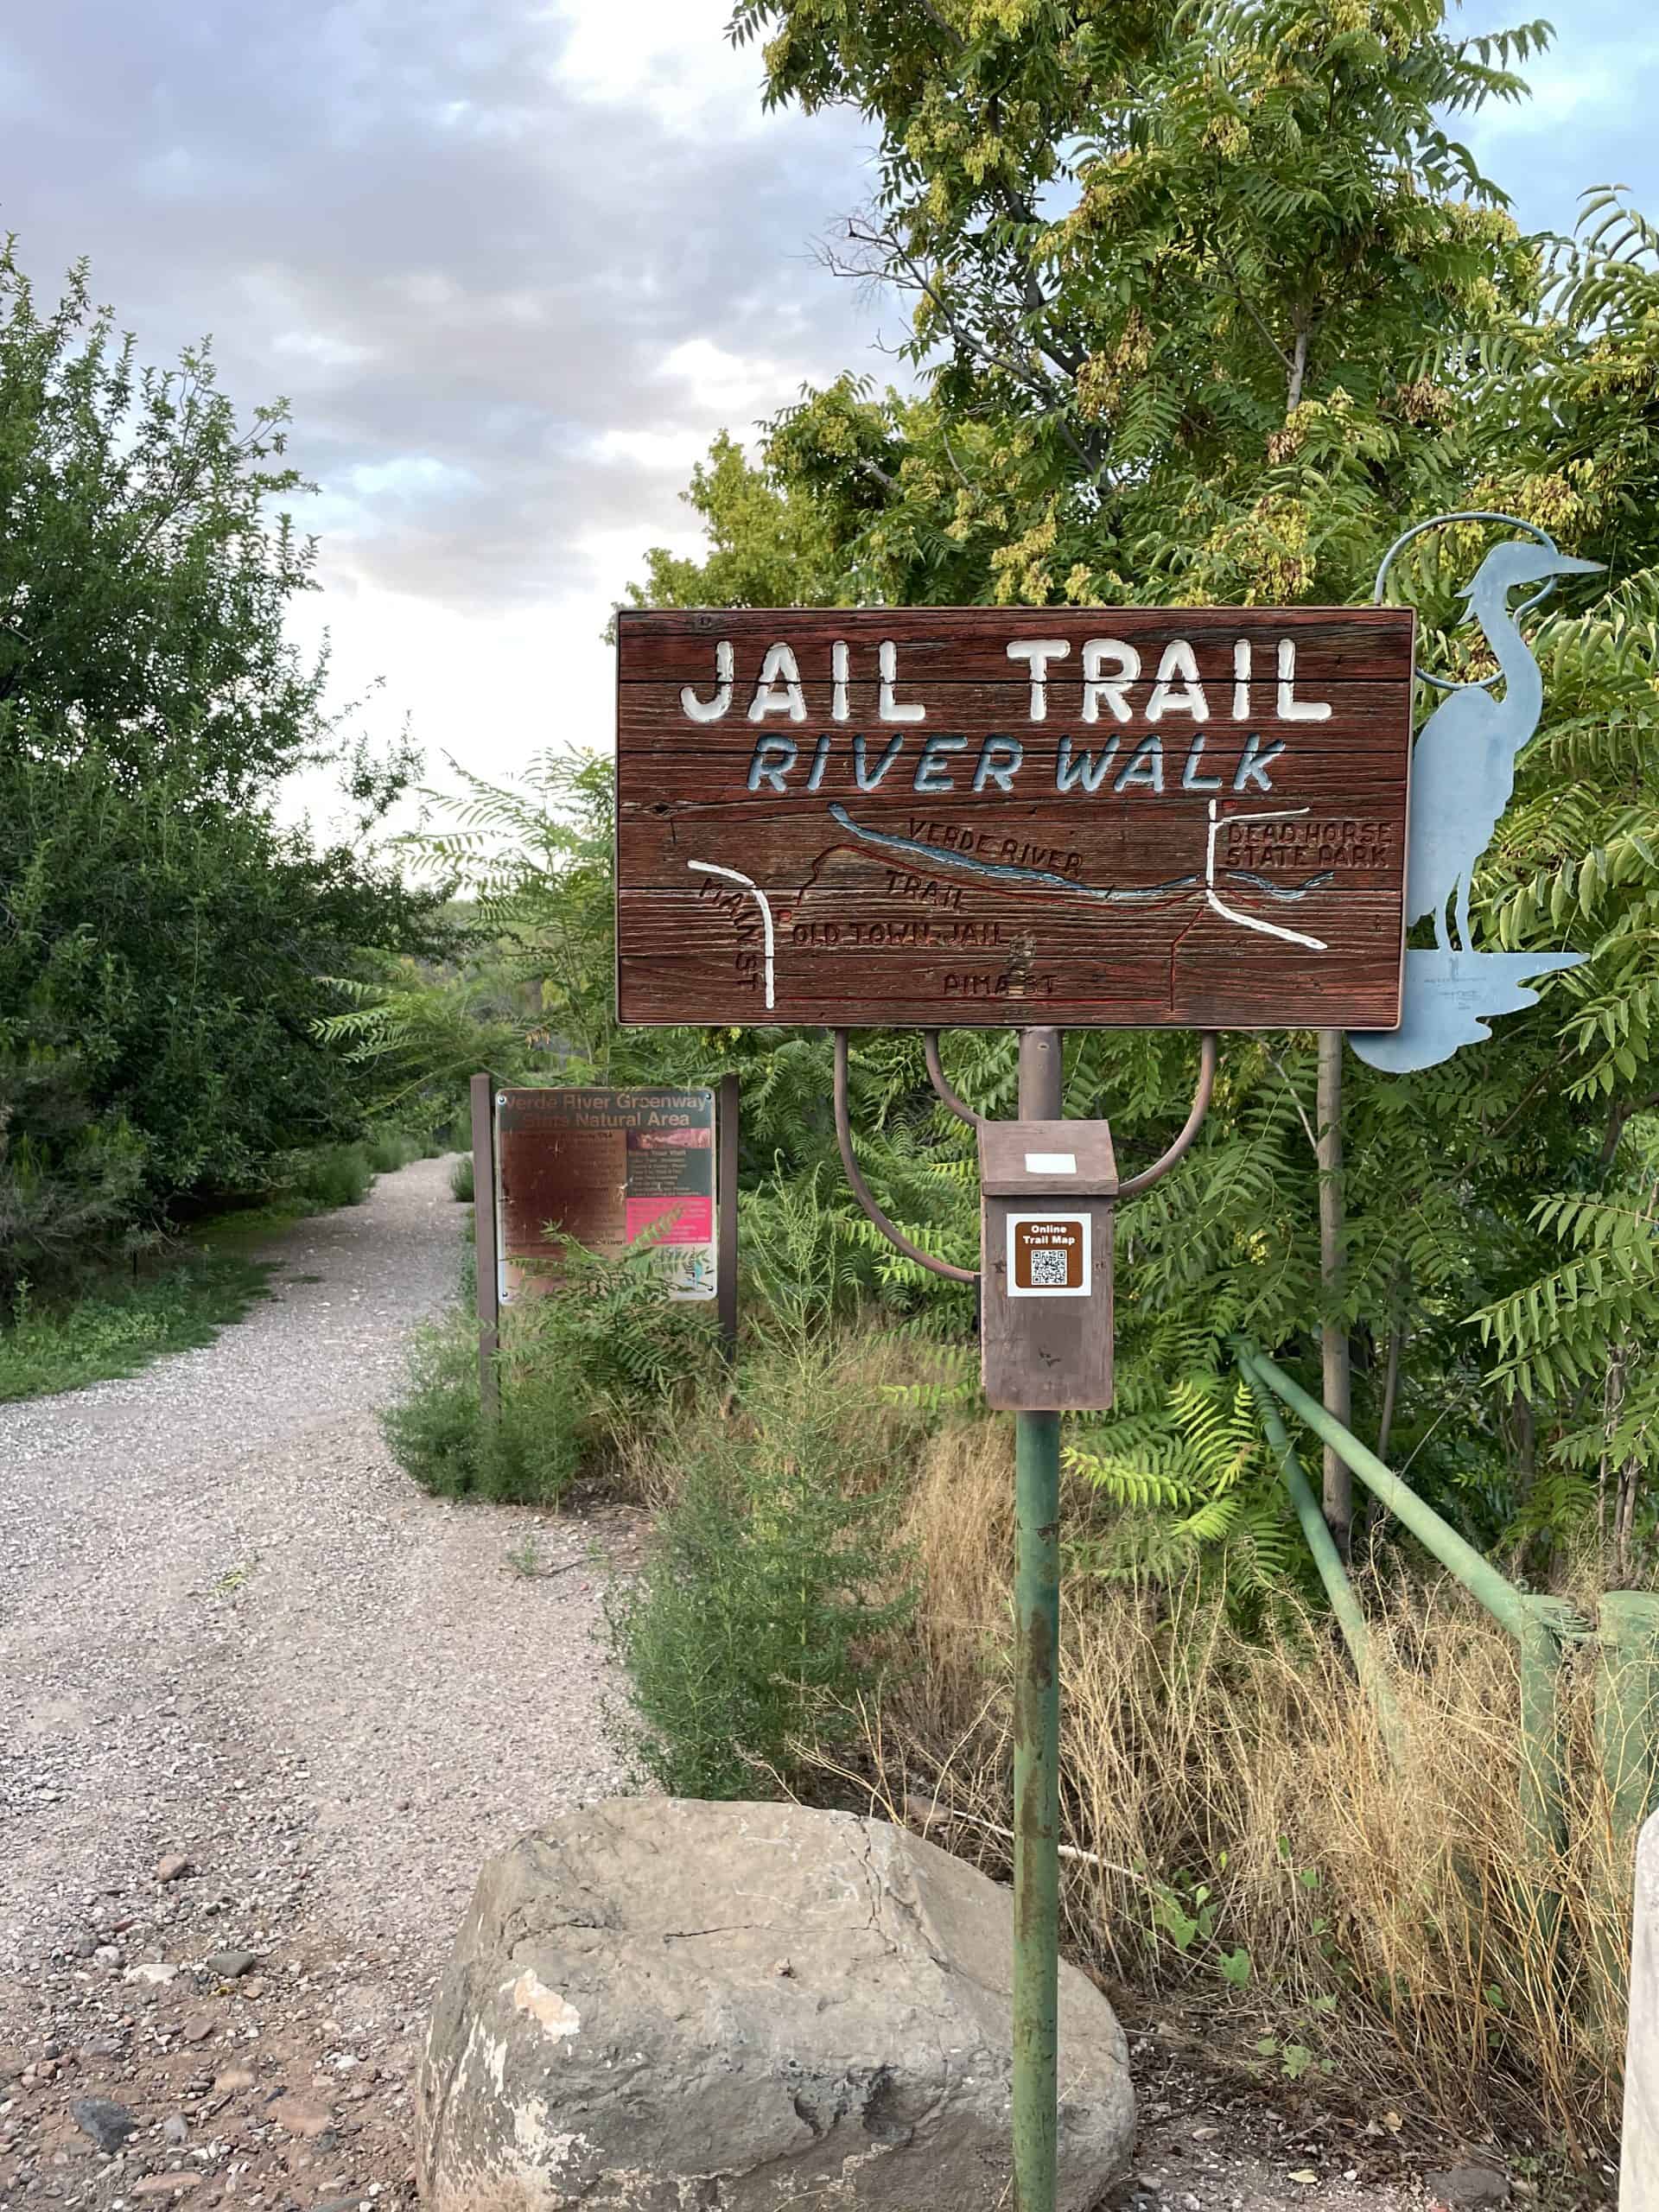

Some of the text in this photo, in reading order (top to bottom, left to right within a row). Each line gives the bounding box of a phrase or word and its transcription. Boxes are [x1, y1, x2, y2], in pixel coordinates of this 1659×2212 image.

[681, 639, 1332, 722] JAIL TRAIL
[747, 733, 1286, 791] RIVER WALK
[1229, 822, 1392, 844] DEAD HORSE
[908, 817, 1083, 877] VERDE RIVER
[1227, 844, 1389, 868] STATE PARK
[886, 870, 968, 912] TRAIL
[700, 877, 763, 990] MAIN ST
[792, 922, 1010, 947] OLD TOWN JAIL
[563, 1095, 610, 1109] River
[617, 1093, 707, 1112] Greenway
[575, 1112, 640, 1127] Natural
[648, 1111, 690, 1126] Area
[1022, 1235, 1076, 1246] Trail Map
[1031, 1224, 1067, 1234] Online
